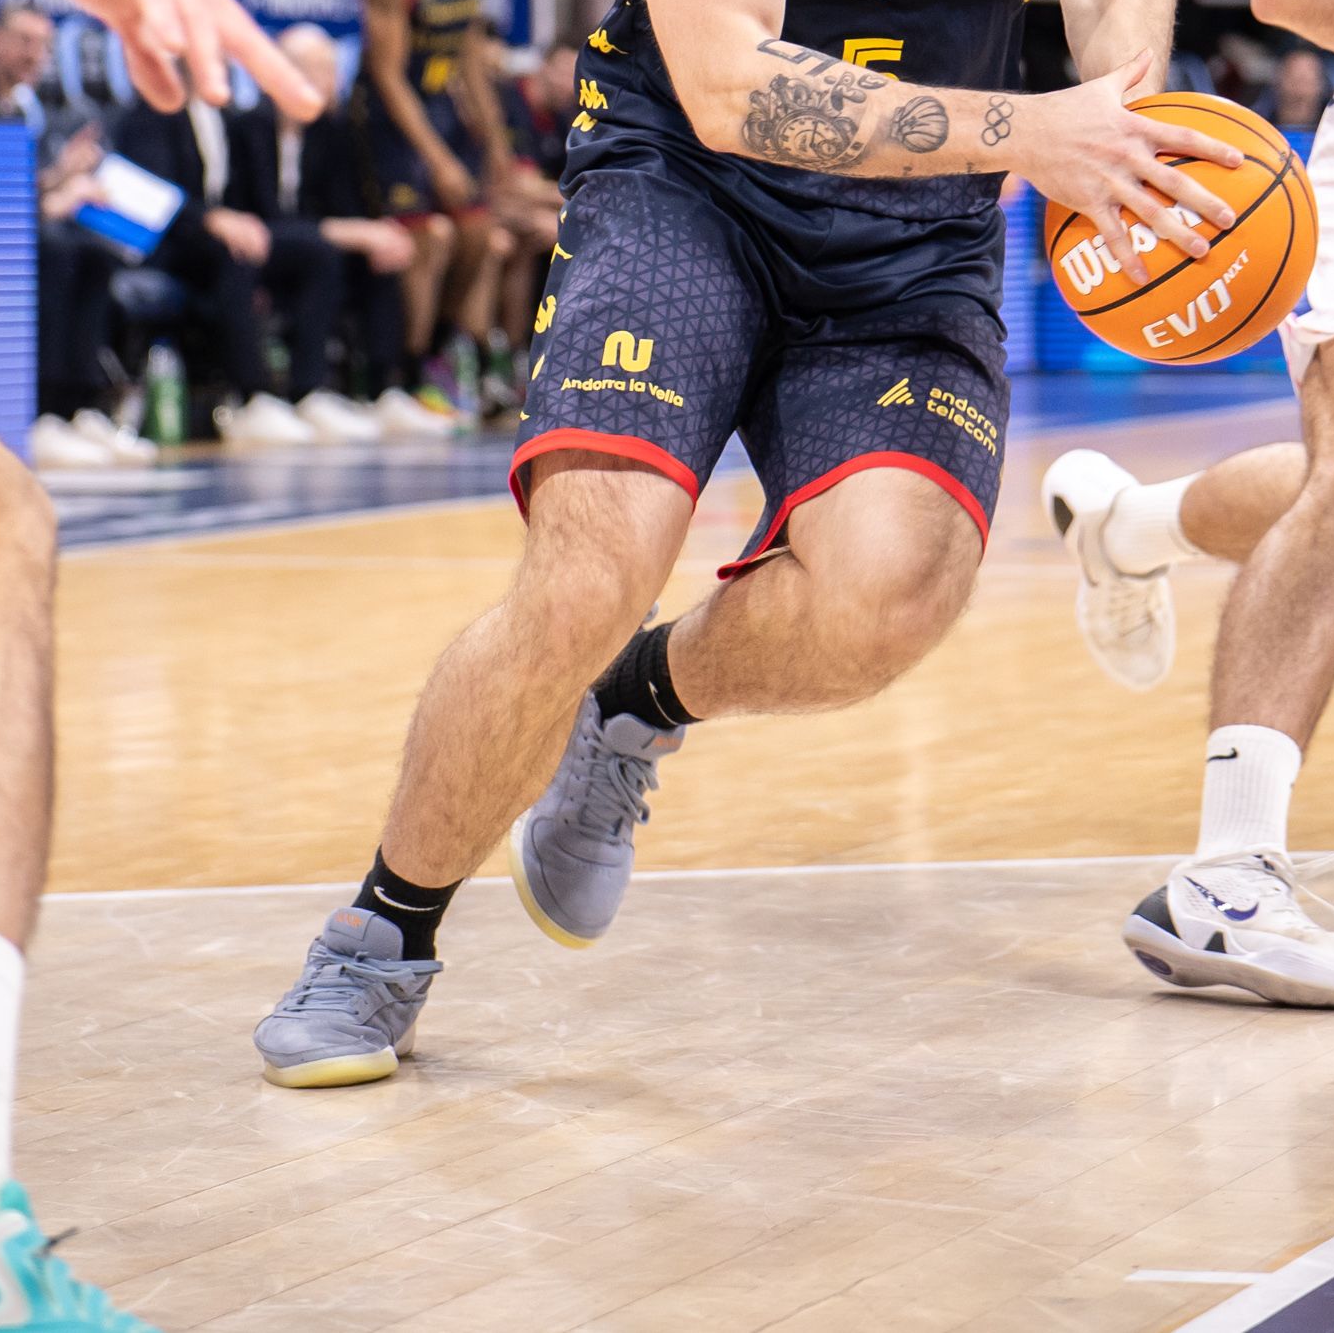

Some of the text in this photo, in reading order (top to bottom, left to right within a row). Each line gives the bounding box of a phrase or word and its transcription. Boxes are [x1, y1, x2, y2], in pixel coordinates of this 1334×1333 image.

[1141, 249, 1250, 349] EVO NXT
[560, 377, 685, 408] Andorra la Vella
[929, 387, 998, 440] andorra
[926, 398, 998, 457] telecom
